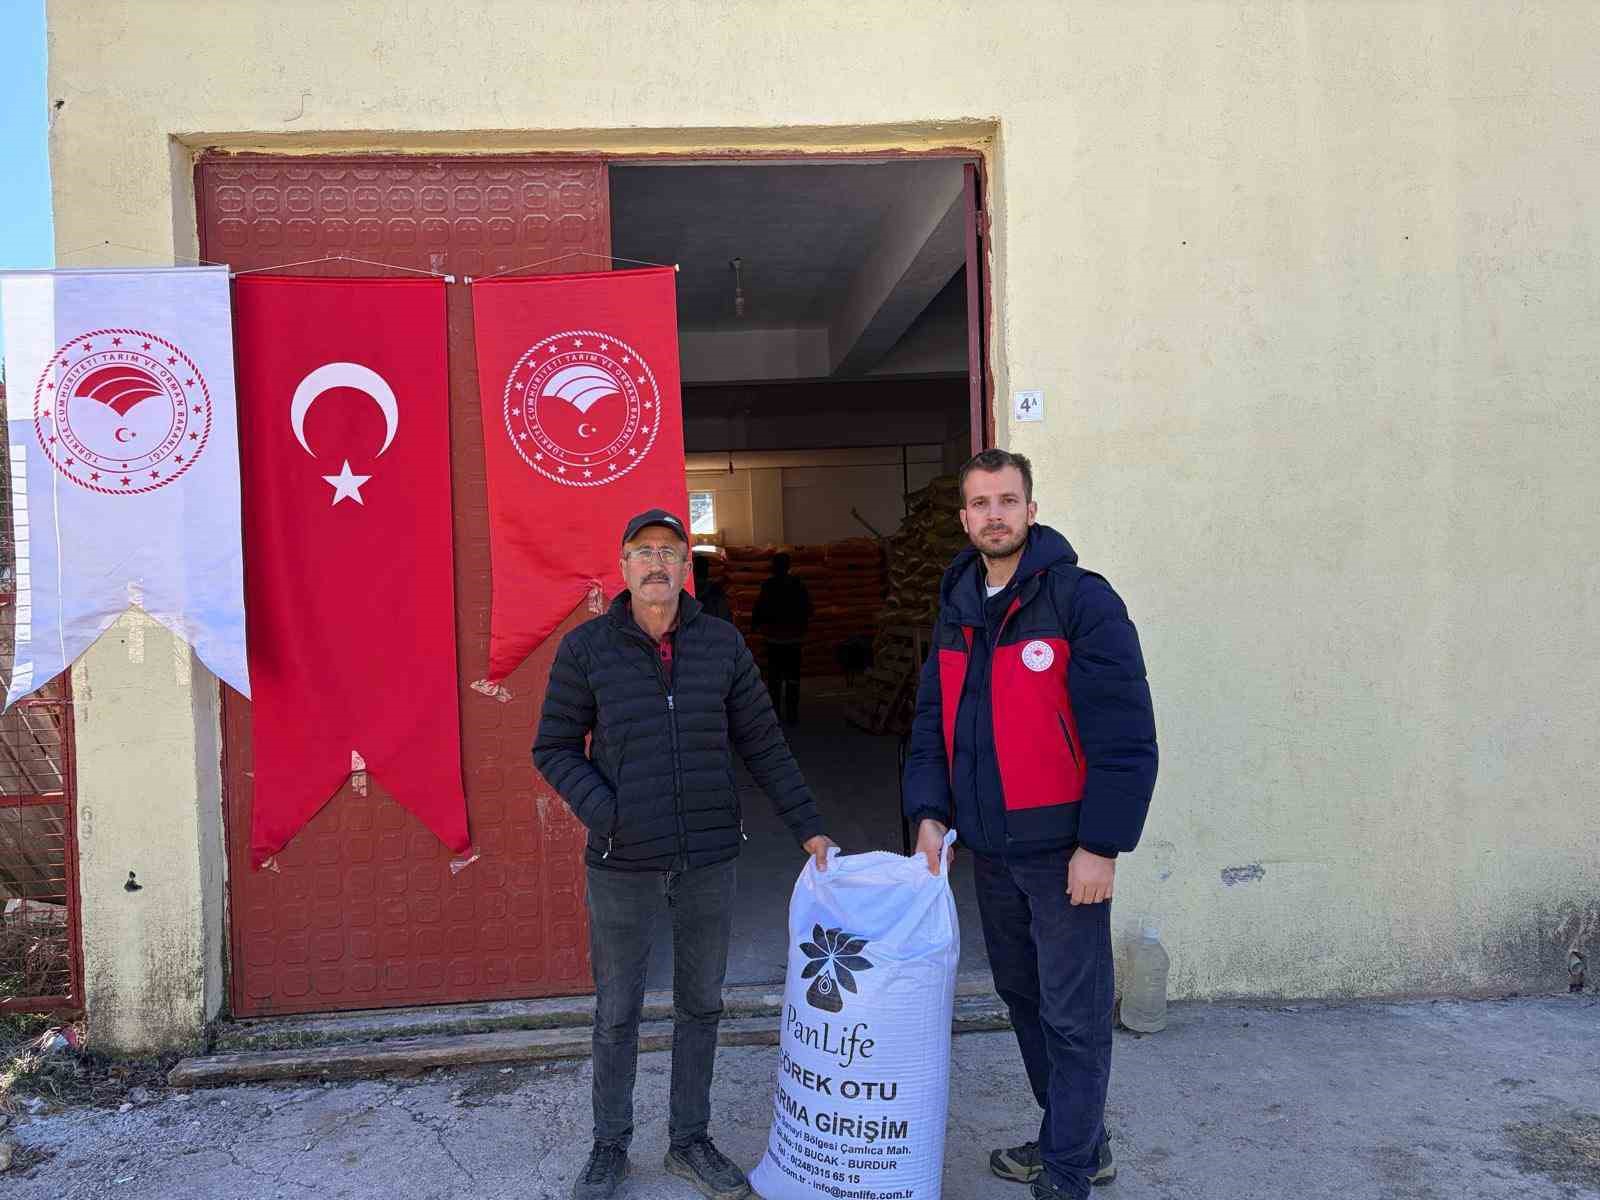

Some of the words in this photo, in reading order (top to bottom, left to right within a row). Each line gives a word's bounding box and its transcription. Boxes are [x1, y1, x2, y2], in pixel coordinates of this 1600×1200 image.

[102, 354, 139, 362] TARIM
[144, 360, 156, 369] VE
[160, 370, 184, 406] ORMAN
[602, 359, 612, 368] VE
[615, 370, 637, 402] ORMAN
[786, 1003, 875, 1068] PanLife
[840, 1080, 897, 1101] OTU
[815, 1111, 909, 1143] GİRİŞİM
[803, 1132, 838, 1151] Bölgesi
[840, 1143, 883, 1155] Çamlıca
[886, 1145, 911, 1156] Mah.
[804, 1148, 839, 1167] BUCAK
[847, 1159, 897, 1170] BURDUR
[790, 1154, 830, 1179] 0(248)315
[832, 1171, 845, 1182] 65
[847, 1174, 860, 1184] 15
[813, 1179, 914, 1200] info@panlife.com.tr
